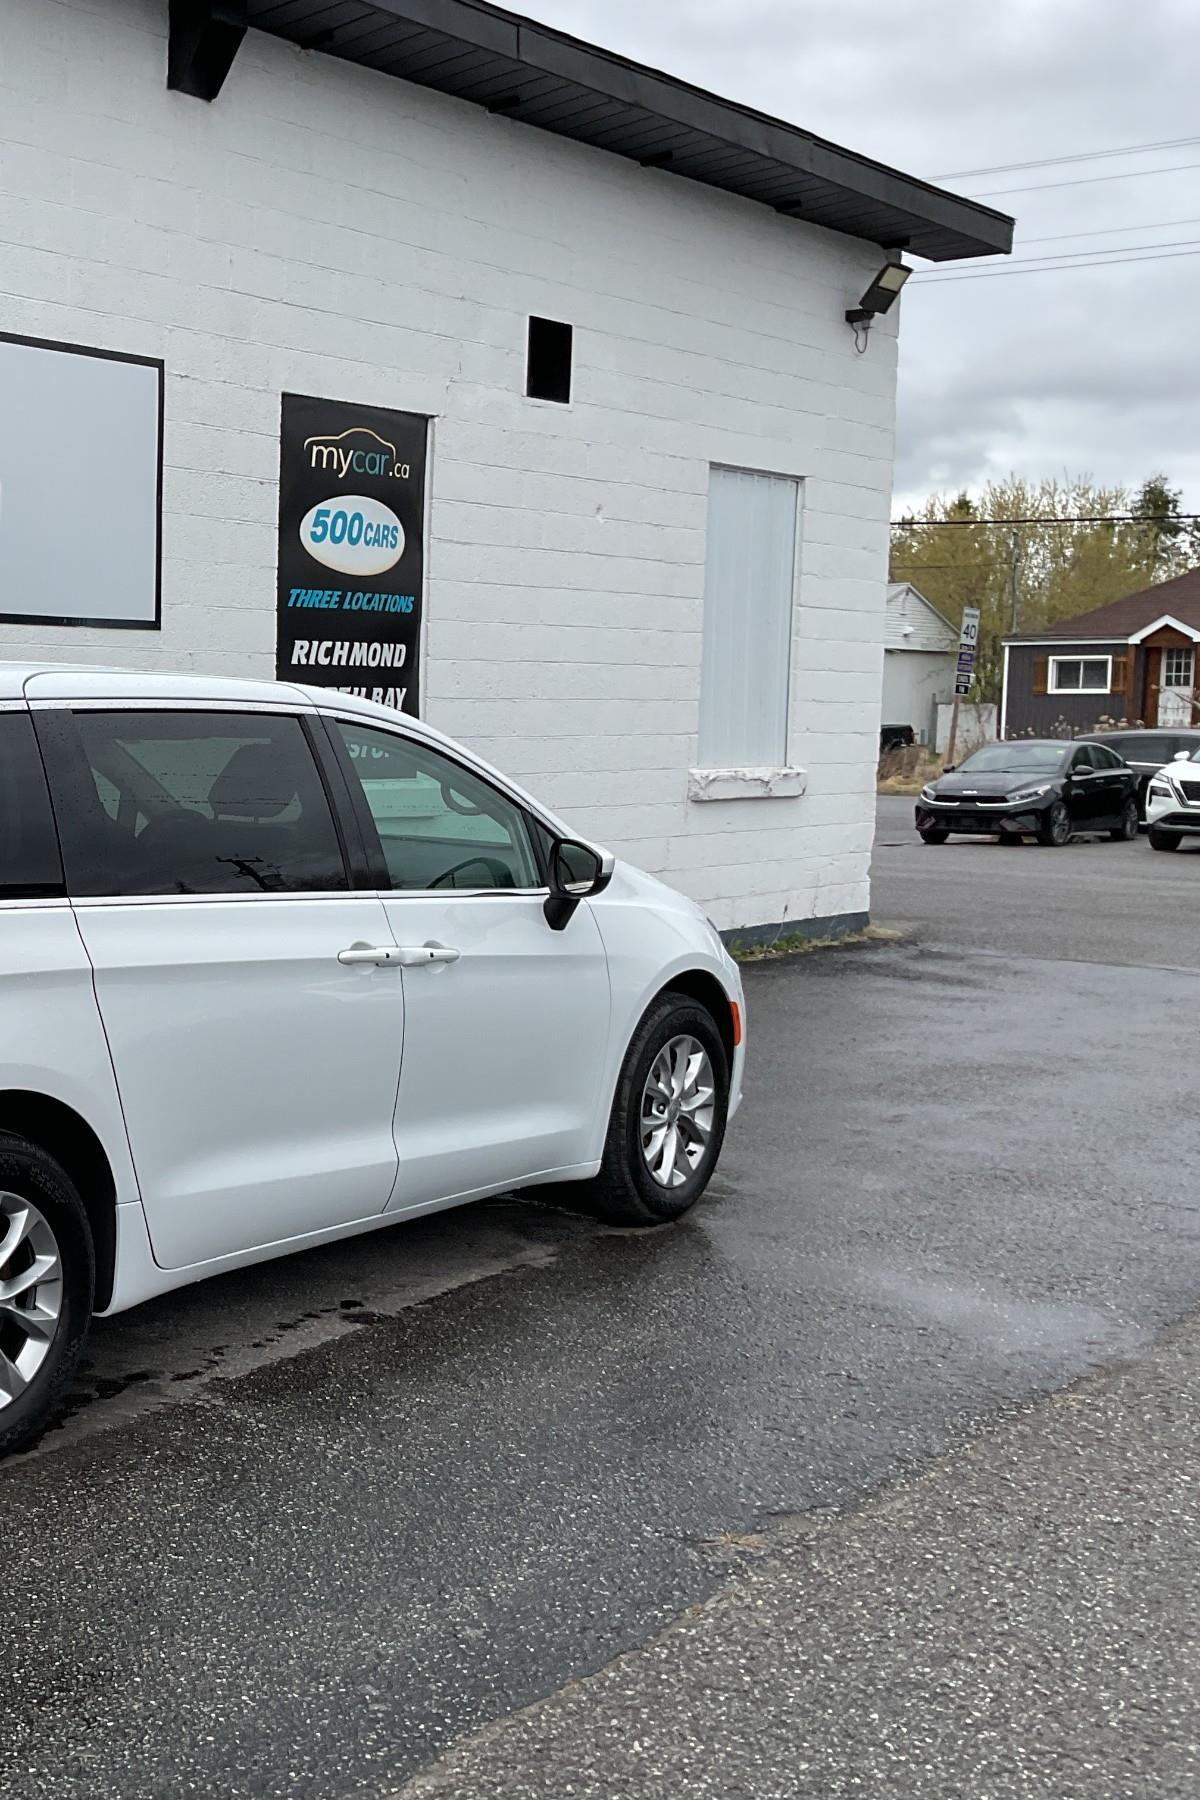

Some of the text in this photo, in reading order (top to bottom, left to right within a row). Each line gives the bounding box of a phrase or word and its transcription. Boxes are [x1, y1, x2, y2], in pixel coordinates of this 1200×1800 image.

[311, 443, 410, 479] mycar.ca
[309, 508, 399, 549] 500 CARS
[287, 588, 415, 614] THREE LOCATIONS
[963, 624, 977, 639] 40
[290, 639, 406, 667] RICHMOND
[371, 687, 407, 711] BAY
